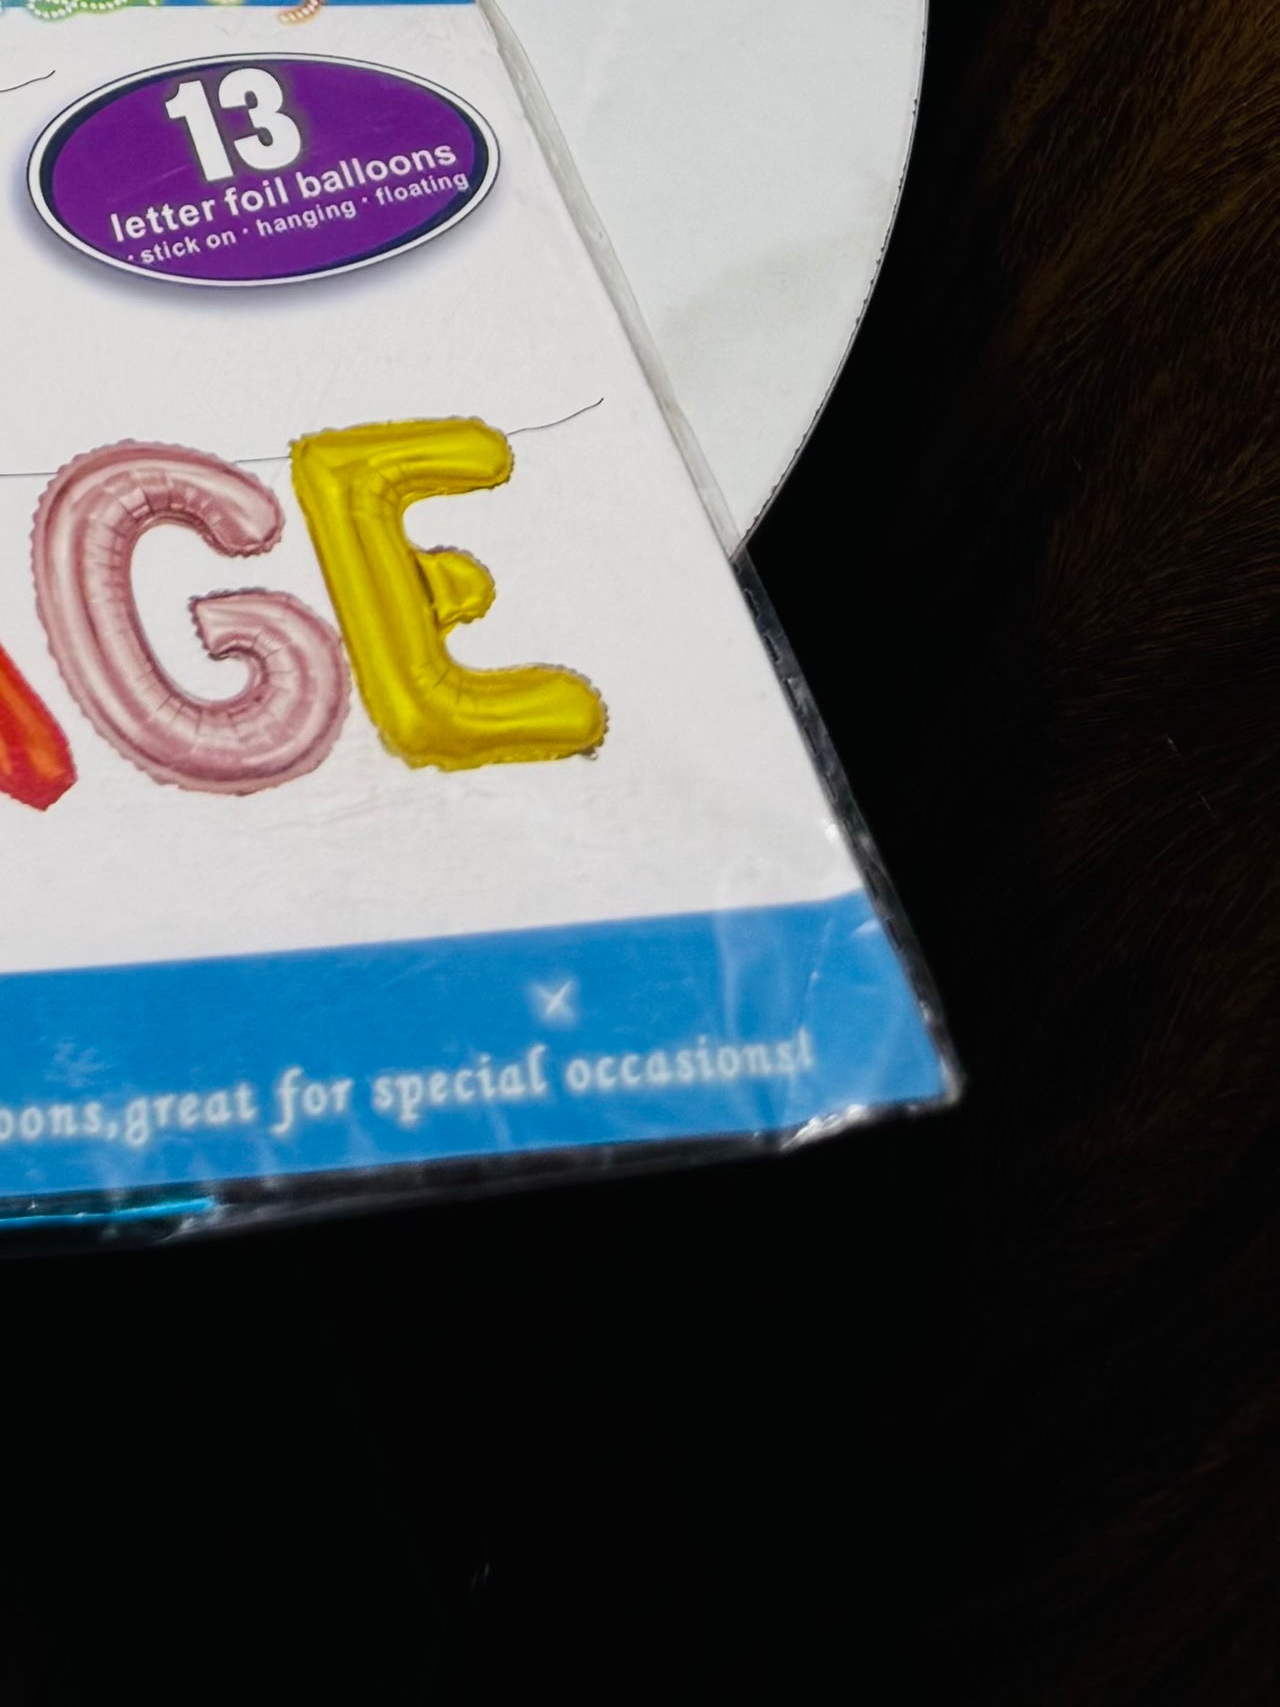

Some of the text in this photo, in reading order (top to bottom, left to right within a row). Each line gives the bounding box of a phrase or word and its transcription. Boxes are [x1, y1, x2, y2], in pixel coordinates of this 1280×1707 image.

[165, 68, 301, 182] 13
[110, 143, 457, 242] letter foil balloons
[206, 228, 236, 250] on
[256, 200, 357, 237] hanging
[375, 171, 468, 206] floating
[273, 1066, 352, 1135] for
[372, 1045, 547, 1127] special
[566, 1027, 812, 1094] occasions!
